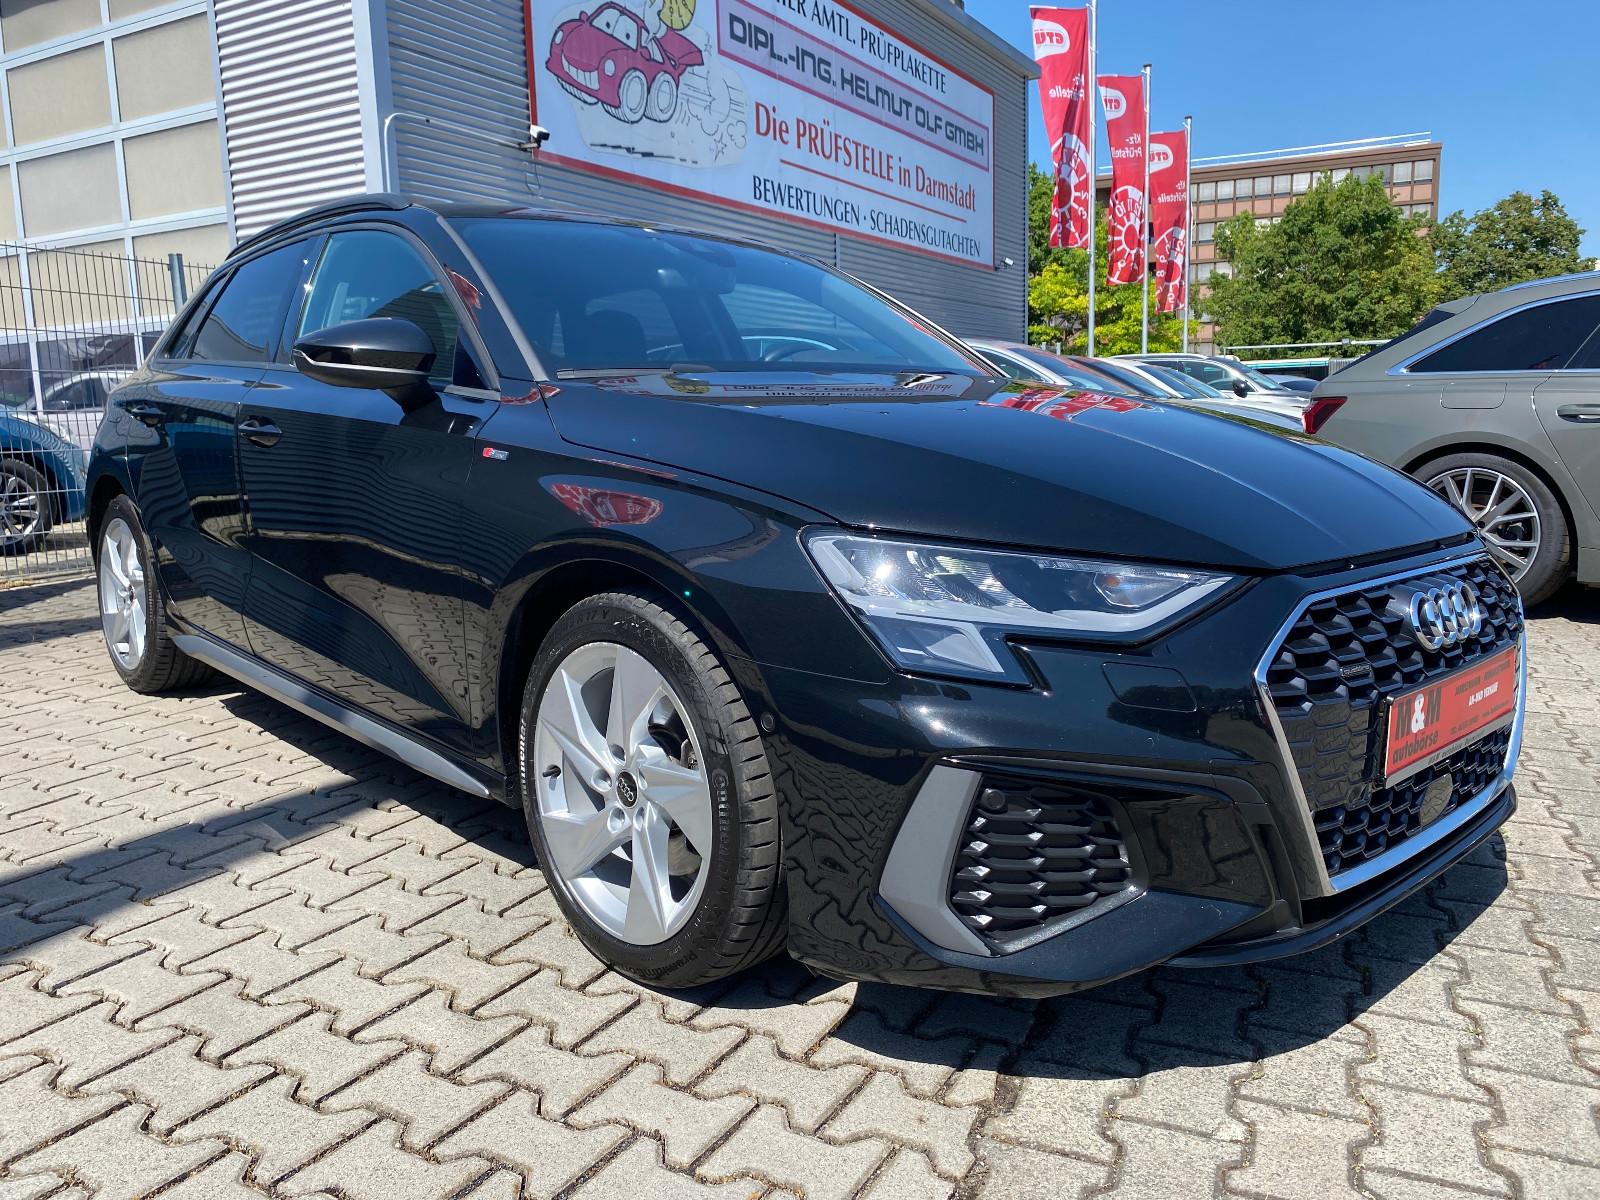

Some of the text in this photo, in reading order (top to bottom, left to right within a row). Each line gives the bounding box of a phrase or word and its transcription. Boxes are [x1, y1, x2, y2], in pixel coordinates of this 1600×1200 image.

[728, 11, 837, 88] DIPL.-ING.
[840, 65, 913, 121] HELMUT
[915, 106, 945, 135] OLF
[811, 0, 856, 45] AMTL.
[860, 31, 947, 95] PRÜFPLAKETTE
[754, 101, 977, 213] Die PRÜFSTELLE in Darmstadt
[752, 175, 982, 257] BEWERTUNGEN SCHADENSGUTACHTEN
[1395, 687, 1442, 741] M&M
